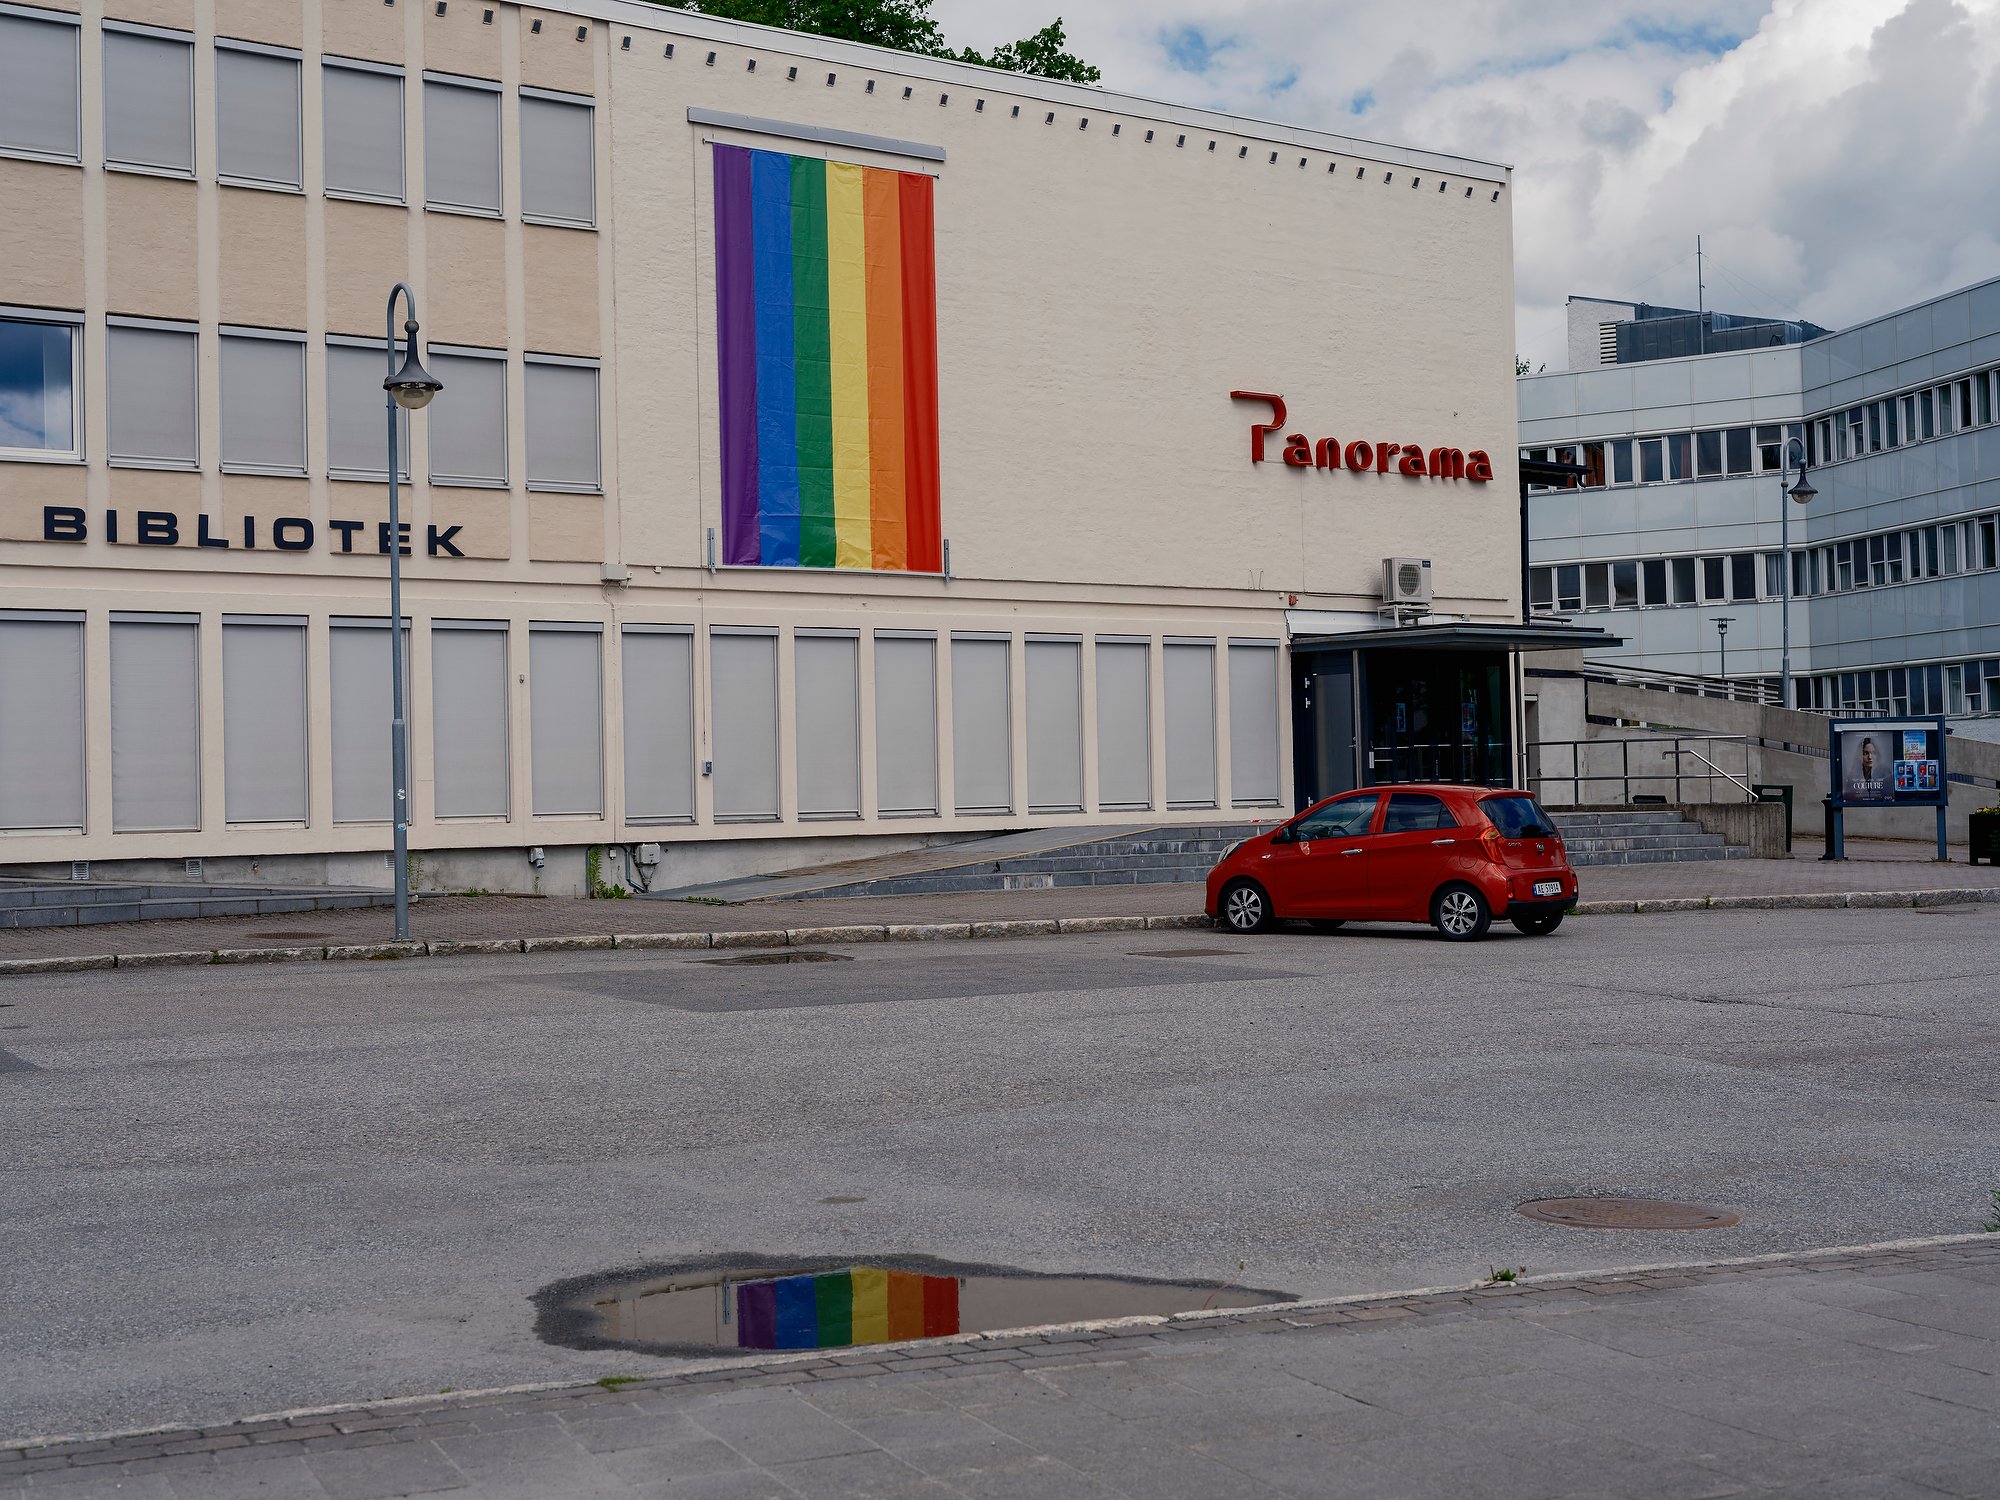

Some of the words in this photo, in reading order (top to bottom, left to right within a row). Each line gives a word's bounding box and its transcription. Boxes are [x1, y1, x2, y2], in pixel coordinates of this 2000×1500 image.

[1230, 390, 1494, 481] Panorama
[44, 506, 466, 557] BIBLIOTEK
[1853, 781, 1884, 790] COUTURE
[1537, 885, 1545, 894] AE
